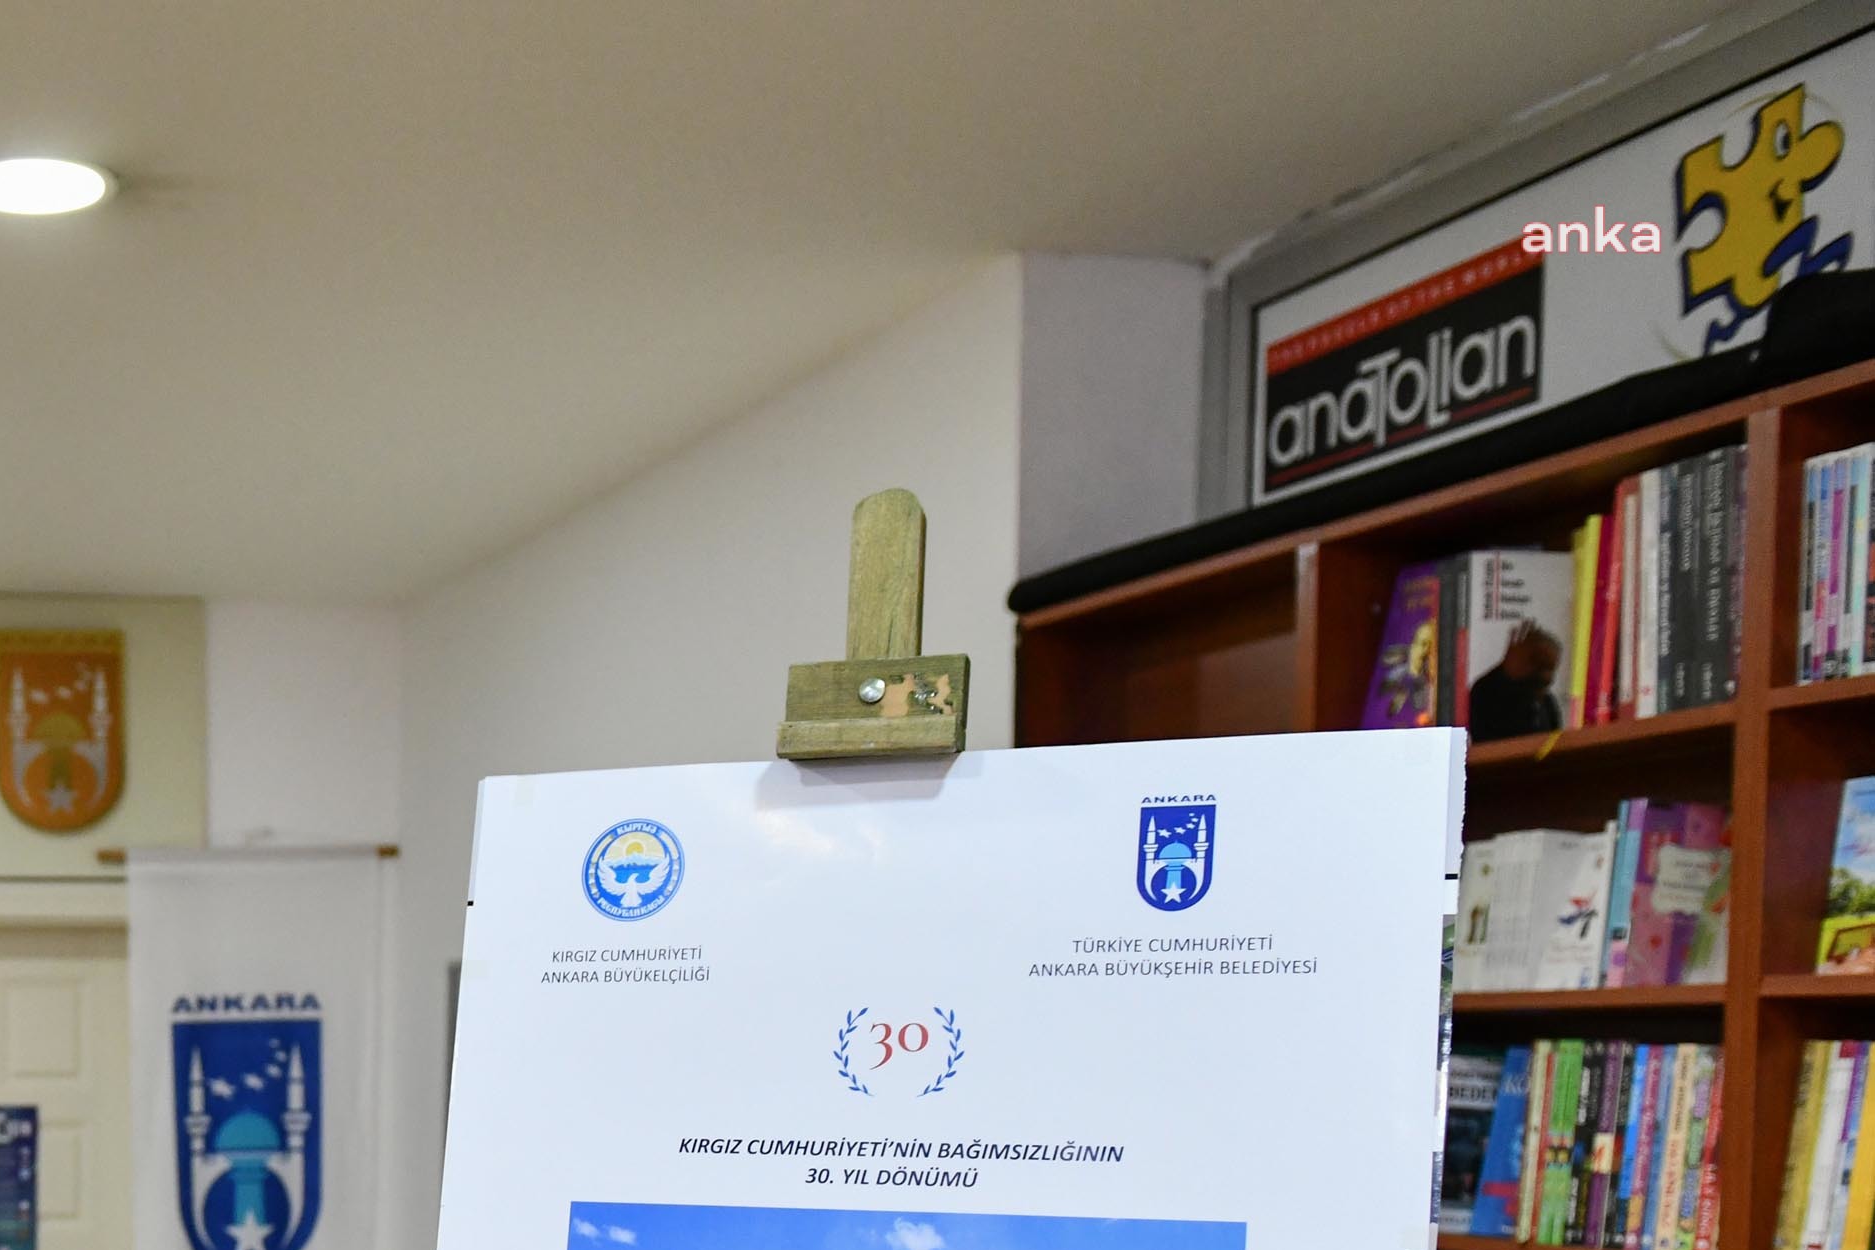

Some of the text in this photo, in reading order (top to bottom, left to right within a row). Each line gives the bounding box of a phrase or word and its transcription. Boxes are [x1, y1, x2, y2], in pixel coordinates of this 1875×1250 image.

[1141, 794, 1217, 804] ANKARA
[552, 945, 702, 963] KIRGIZ CUMHURİYETİ
[1072, 934, 1274, 954] TÜRKİYE CUMHURİYETİ
[541, 966, 710, 985] ANKARA BÜYÜKELÇİLİĞİ
[1029, 957, 1318, 979] ANKARA BÜYÜKŞEHİR BELEDİYESİ
[171, 992, 323, 1014] ANKARA
[869, 1022, 929, 1070] 30
[679, 1137, 1125, 1163] KIRGIZ CUMHURİYETİ’NİN BAĞIMSIZLIĞININ
[804, 1166, 979, 1189] 30. YIL DÖNÜMÜ
